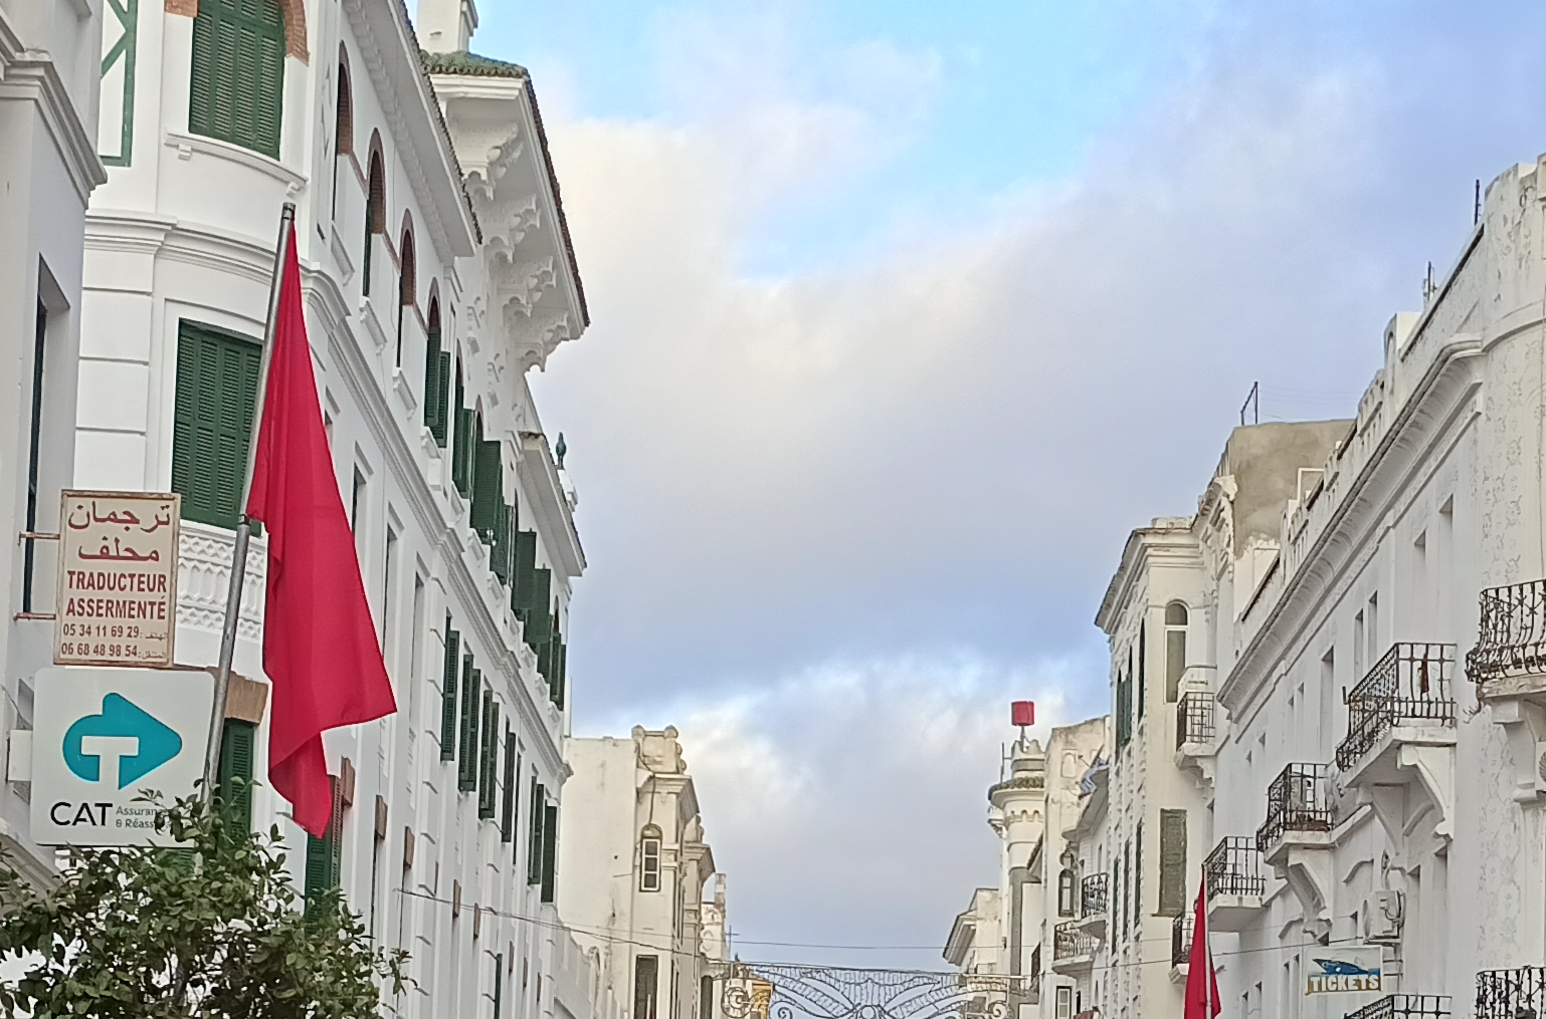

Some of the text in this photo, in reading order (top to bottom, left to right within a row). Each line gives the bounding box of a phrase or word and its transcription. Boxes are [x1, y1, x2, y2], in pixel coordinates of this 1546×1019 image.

[68, 501, 171, 533] ترجمان
[78, 536, 160, 562] محلف
[67, 570, 167, 593] TRADUCTEUR
[65, 596, 166, 620] ASSERMENTÉ
[63, 623, 76, 637] 05
[79, 624, 92, 637] 34
[95, 624, 107, 638] 11
[110, 625, 124, 638] 69
[126, 626, 140, 639] 29
[61, 643, 74, 655] 06
[77, 643, 90, 656] 68
[93, 643, 106, 656] 48
[109, 644, 122, 657] 98
[124, 645, 138, 657] 54
[50, 801, 113, 827] CAT
[1310, 975, 1379, 992] TICKETS
